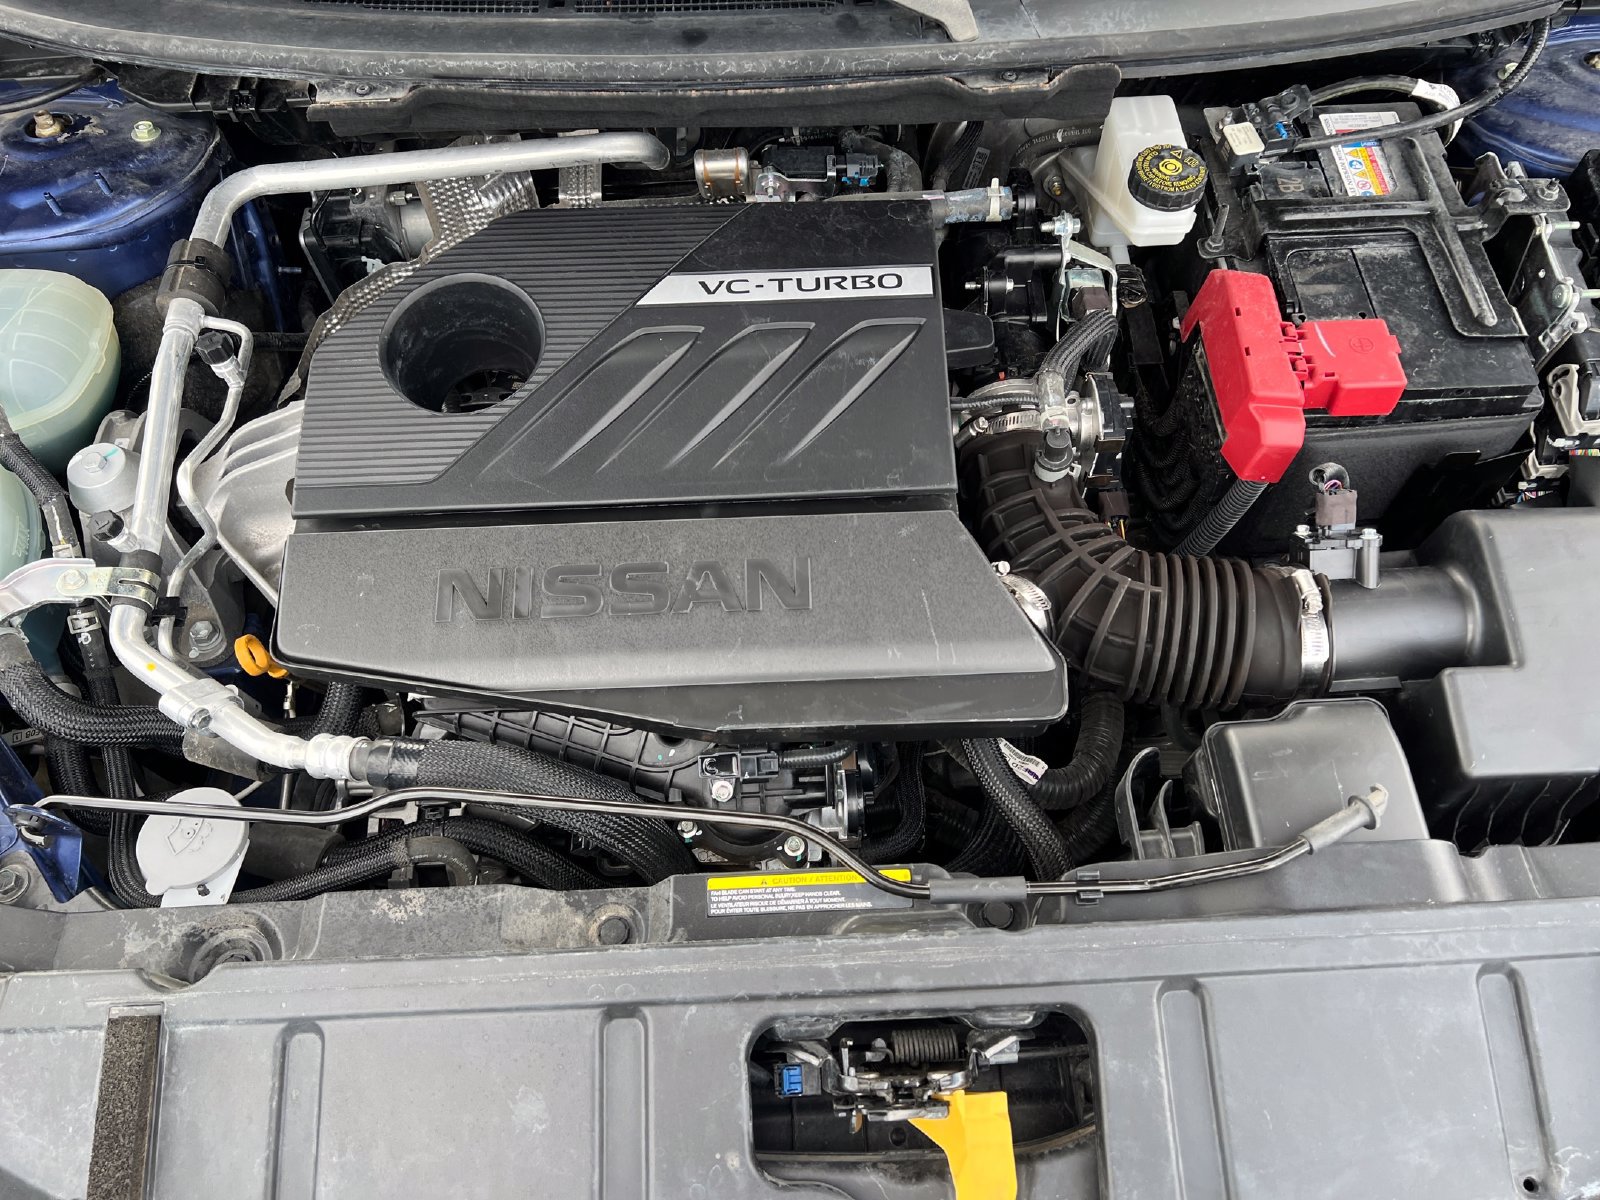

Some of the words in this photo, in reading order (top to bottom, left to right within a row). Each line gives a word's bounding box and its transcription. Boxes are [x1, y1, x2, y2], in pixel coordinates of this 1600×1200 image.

[1154, 177, 1172, 187] BEFORE
[698, 273, 902, 295] VC-TURBO
[435, 556, 813, 623] NISSAN
[772, 876, 807, 885] CAUTION
[816, 874, 858, 882] ATTENTION
